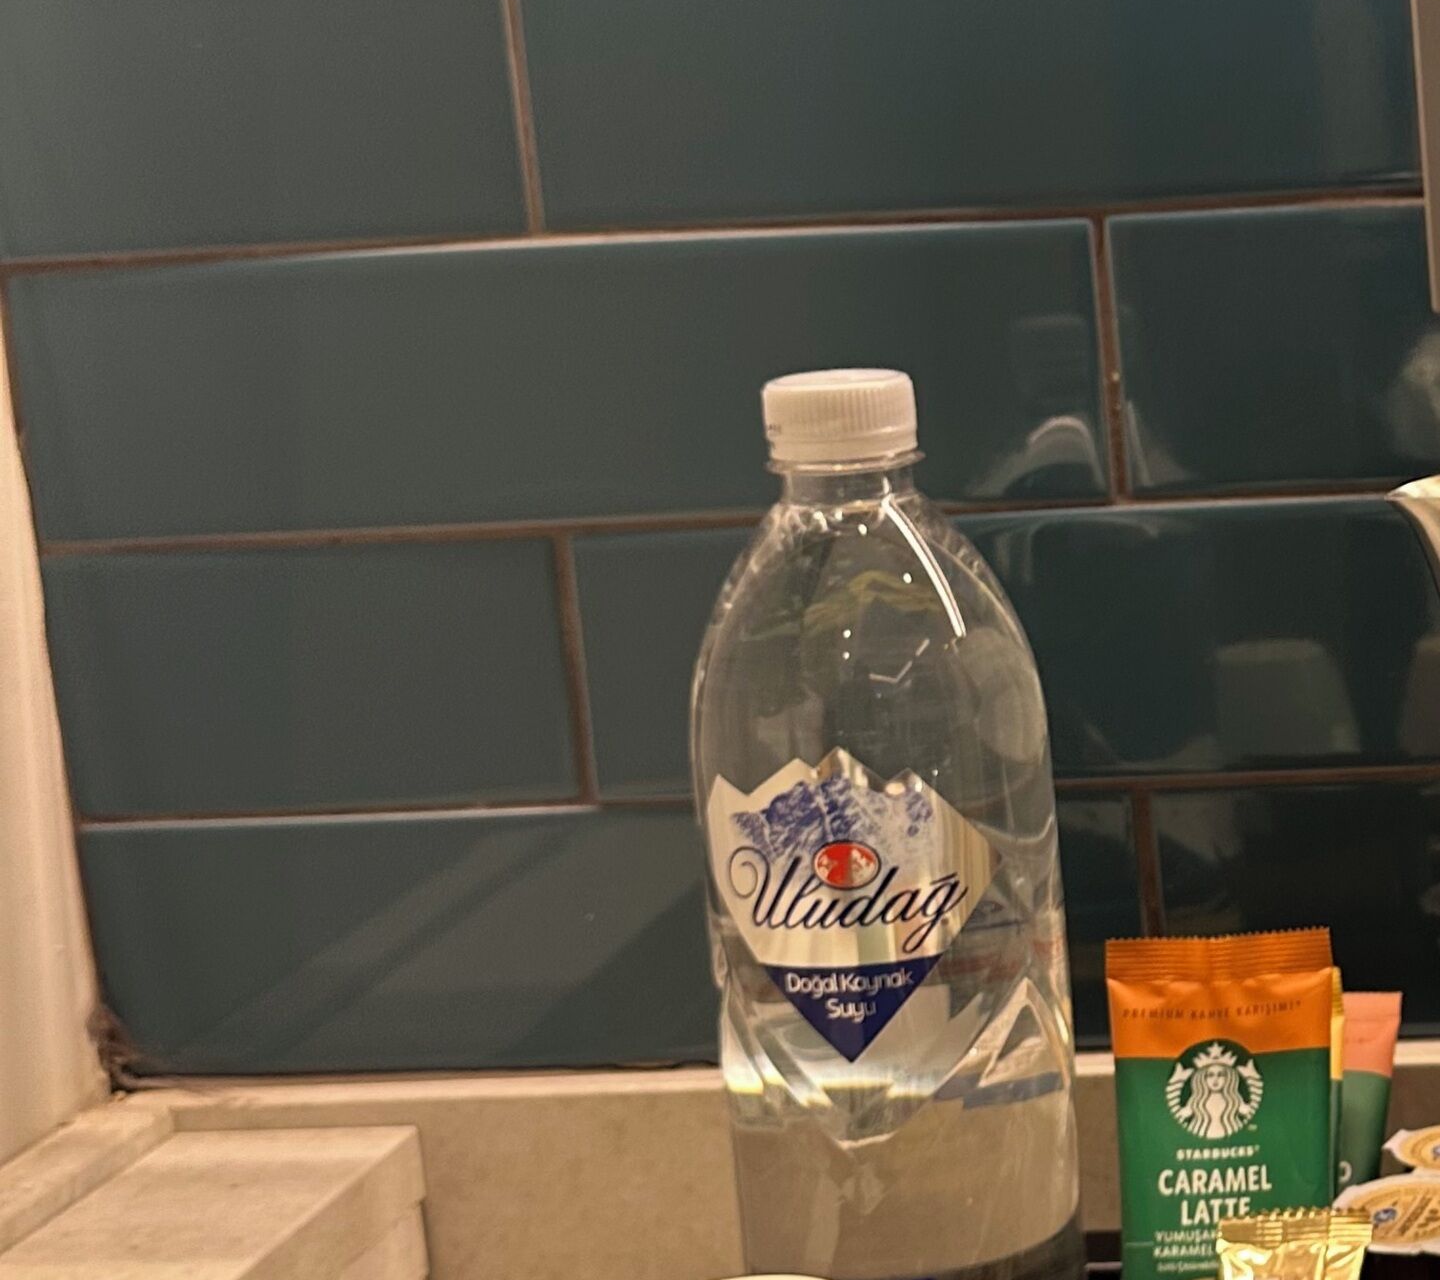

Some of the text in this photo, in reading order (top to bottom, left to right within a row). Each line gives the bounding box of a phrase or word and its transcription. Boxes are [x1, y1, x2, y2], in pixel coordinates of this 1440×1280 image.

[729, 845, 968, 954] Uludağ
[785, 967, 914, 999] Doğal Kaynak
[825, 998, 877, 1023] Suyu
[1157, 1164, 1273, 1196] CARAMEL
[1181, 1196, 1251, 1226] LATTE
